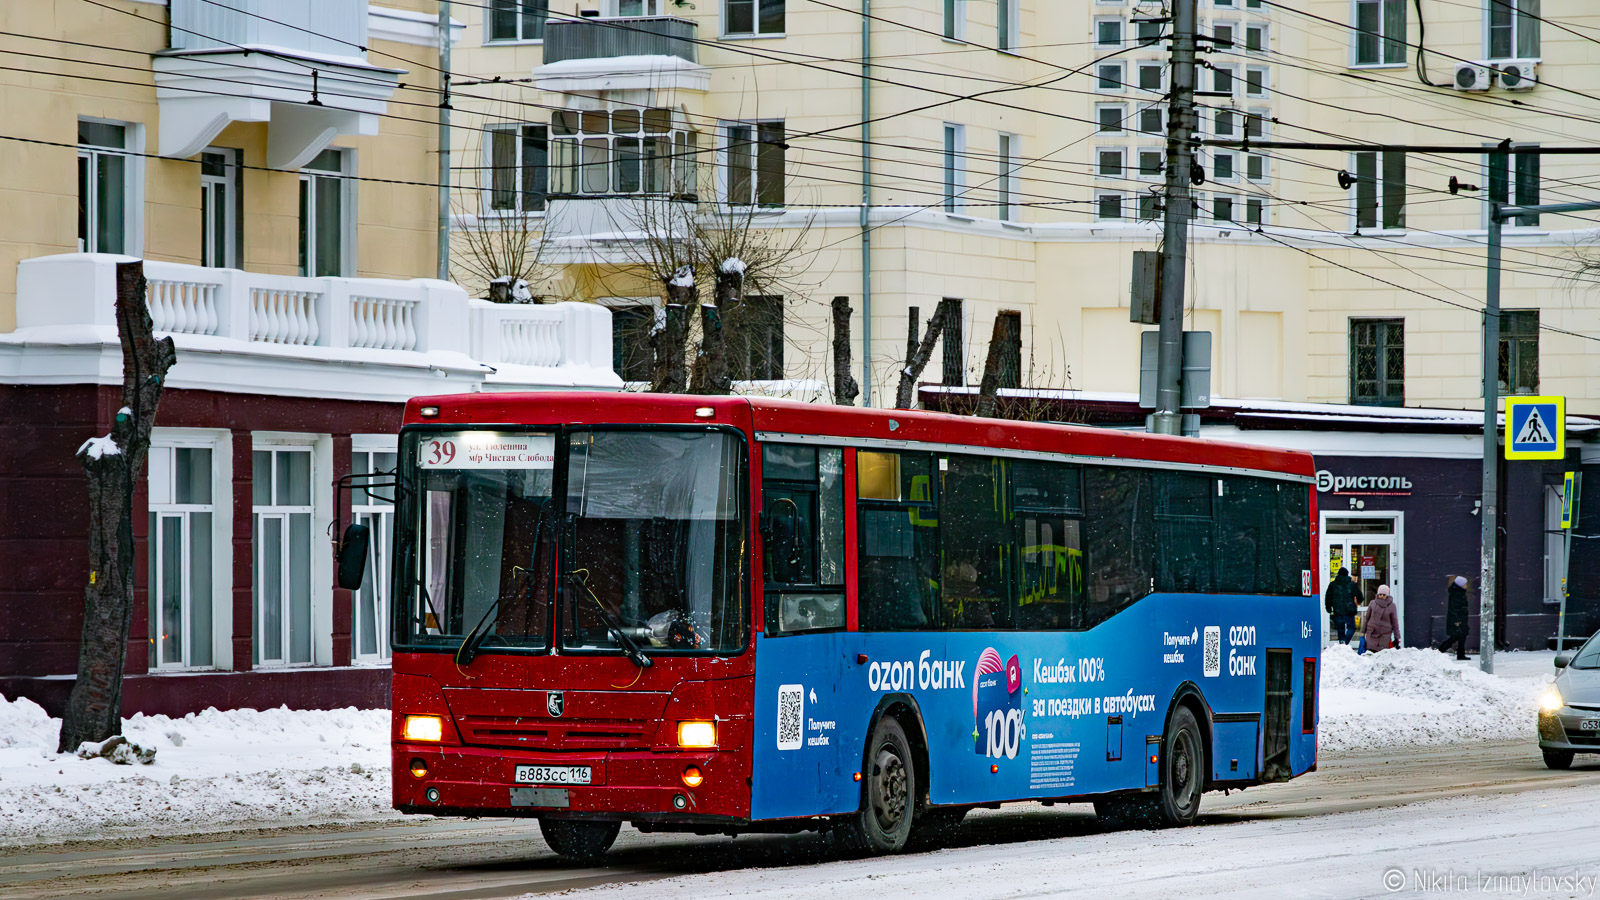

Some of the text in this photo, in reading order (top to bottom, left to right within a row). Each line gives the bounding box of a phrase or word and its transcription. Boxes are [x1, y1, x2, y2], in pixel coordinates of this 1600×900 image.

[428, 440, 456, 465] 39
[468, 452, 555, 463] м/р Чистая Слобода
[1316, 469, 1413, 493] Бристоль
[1302, 571, 1311, 594] 39
[1163, 631, 1191, 648] Получите
[1229, 625, 1256, 647] ozon
[1301, 621, 1313, 639] 16+
[1163, 650, 1185, 664] кешбэк
[1228, 648, 1257, 677] банк
[868, 649, 966, 692] ozon банк
[1033, 656, 1105, 684] Кешбэк 100%
[1032, 688, 1156, 719] за поездки в автобусах
[807, 717, 837, 732] Получите
[984, 707, 1027, 760] 100%
[1582, 720, 1600, 730] О53
[807, 733, 831, 747] кешбэк
[519, 767, 588, 782] В883СС 116
